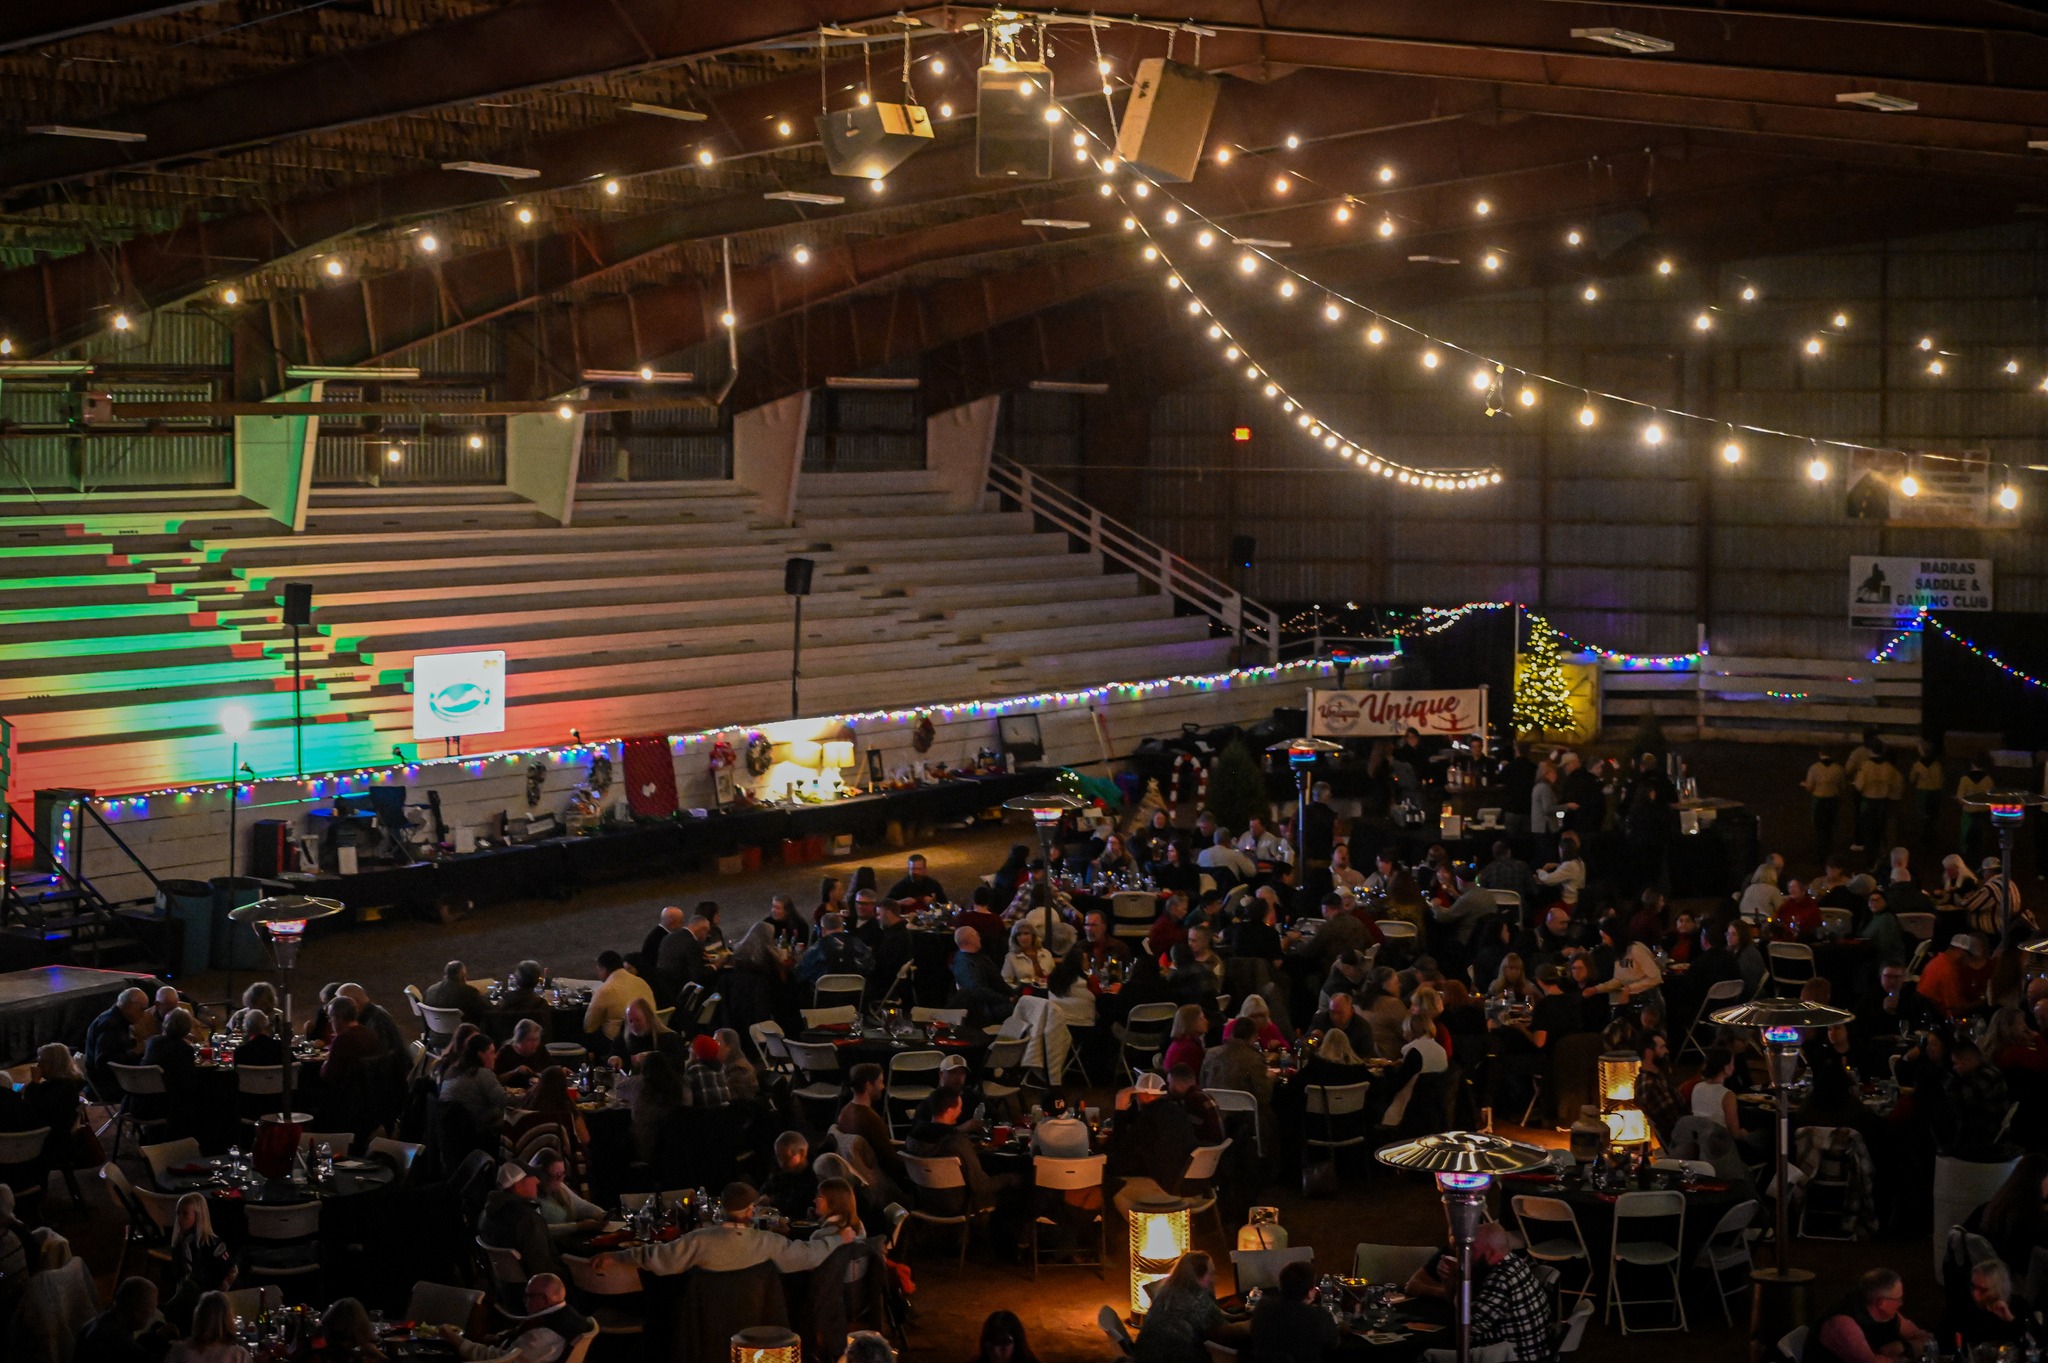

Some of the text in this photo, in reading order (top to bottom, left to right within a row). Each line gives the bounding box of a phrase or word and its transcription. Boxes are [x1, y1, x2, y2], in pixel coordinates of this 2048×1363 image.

[1920, 562, 1975, 574] MADRAS
[1915, 578, 1980, 591] SADDLE &
[1896, 594, 1988, 608] GAMING CLUB
[1359, 693, 1460, 727] Unique
